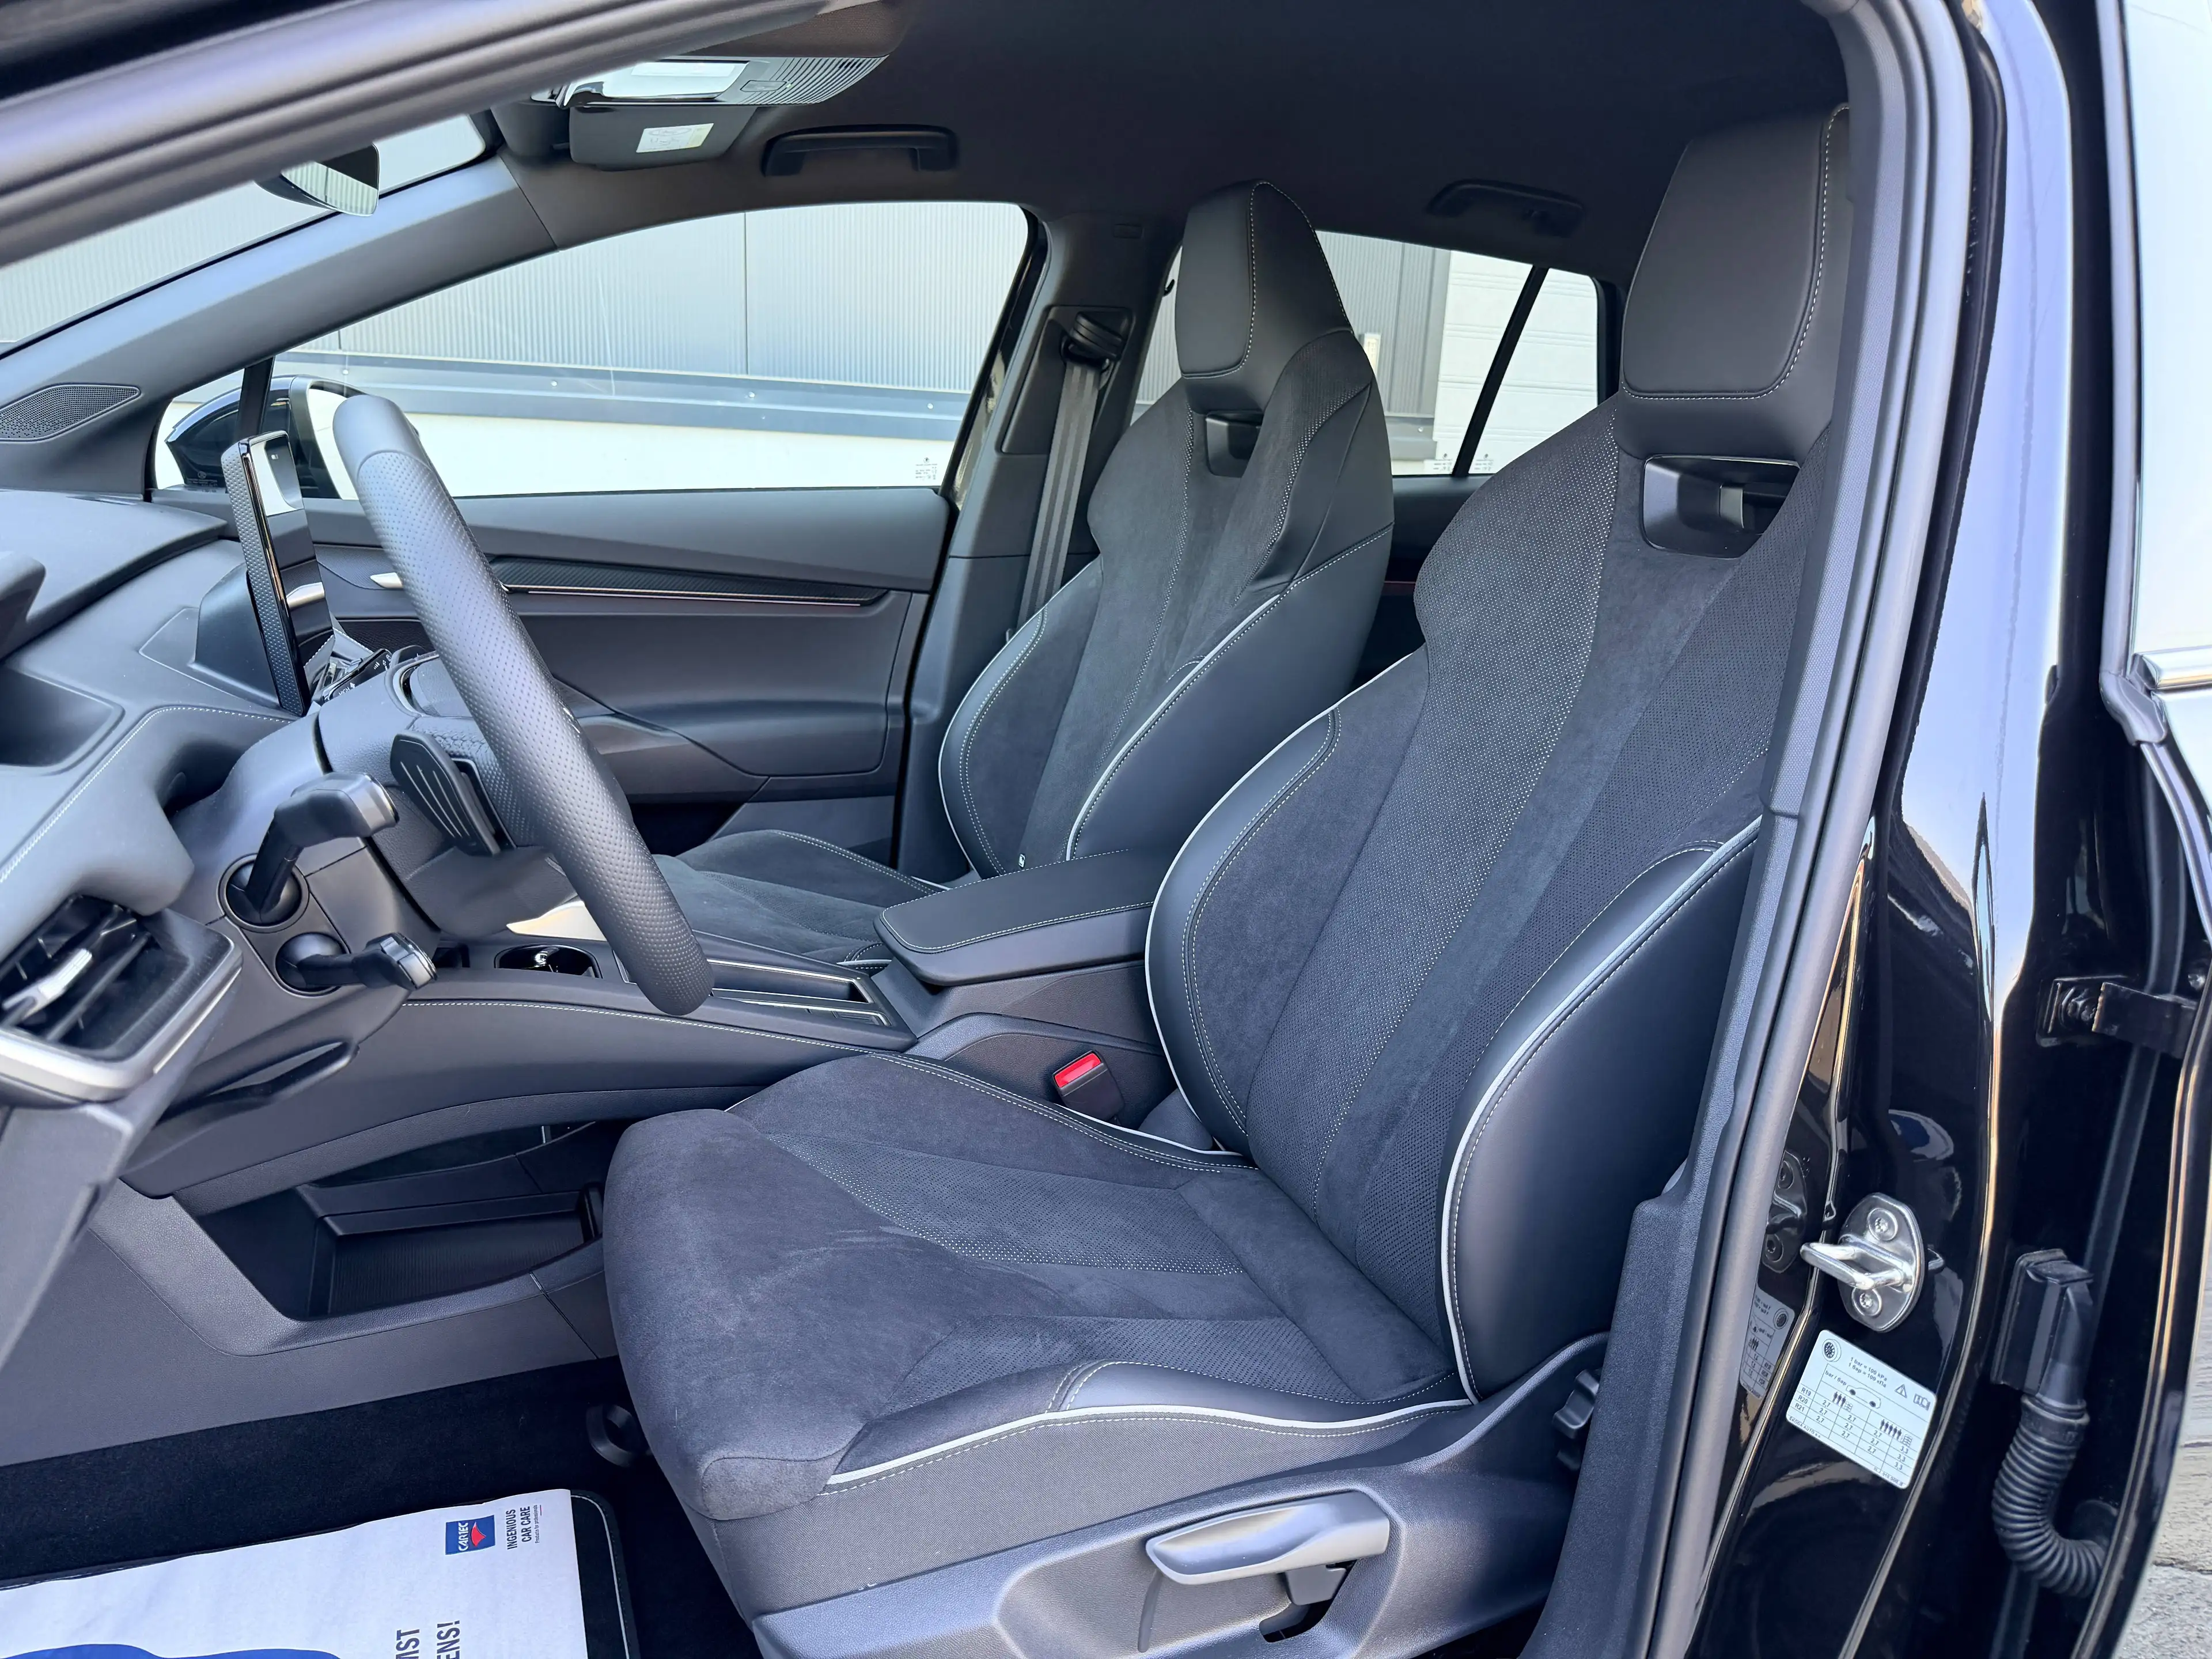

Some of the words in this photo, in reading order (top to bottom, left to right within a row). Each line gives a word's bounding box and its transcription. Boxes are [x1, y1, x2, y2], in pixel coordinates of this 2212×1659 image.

[1868, 1367, 1877, 1375] 100
[1878, 1373, 1887, 1381] kPa
[1801, 1387, 1811, 1396] R19
[1795, 1403, 1805, 1412] R21
[1842, 1430, 1850, 1438] 2,7
[1894, 1462, 1903, 1470] 3,3
[1798, 1395, 1808, 1404] R20
[1897, 1454, 1906, 1462] 3,3
[520, 1506, 531, 1525] CARE
[458, 1522, 468, 1551] CARTEC
[506, 1509, 517, 1550] INGENIOUS
[521, 1527, 532, 1542] CAR
